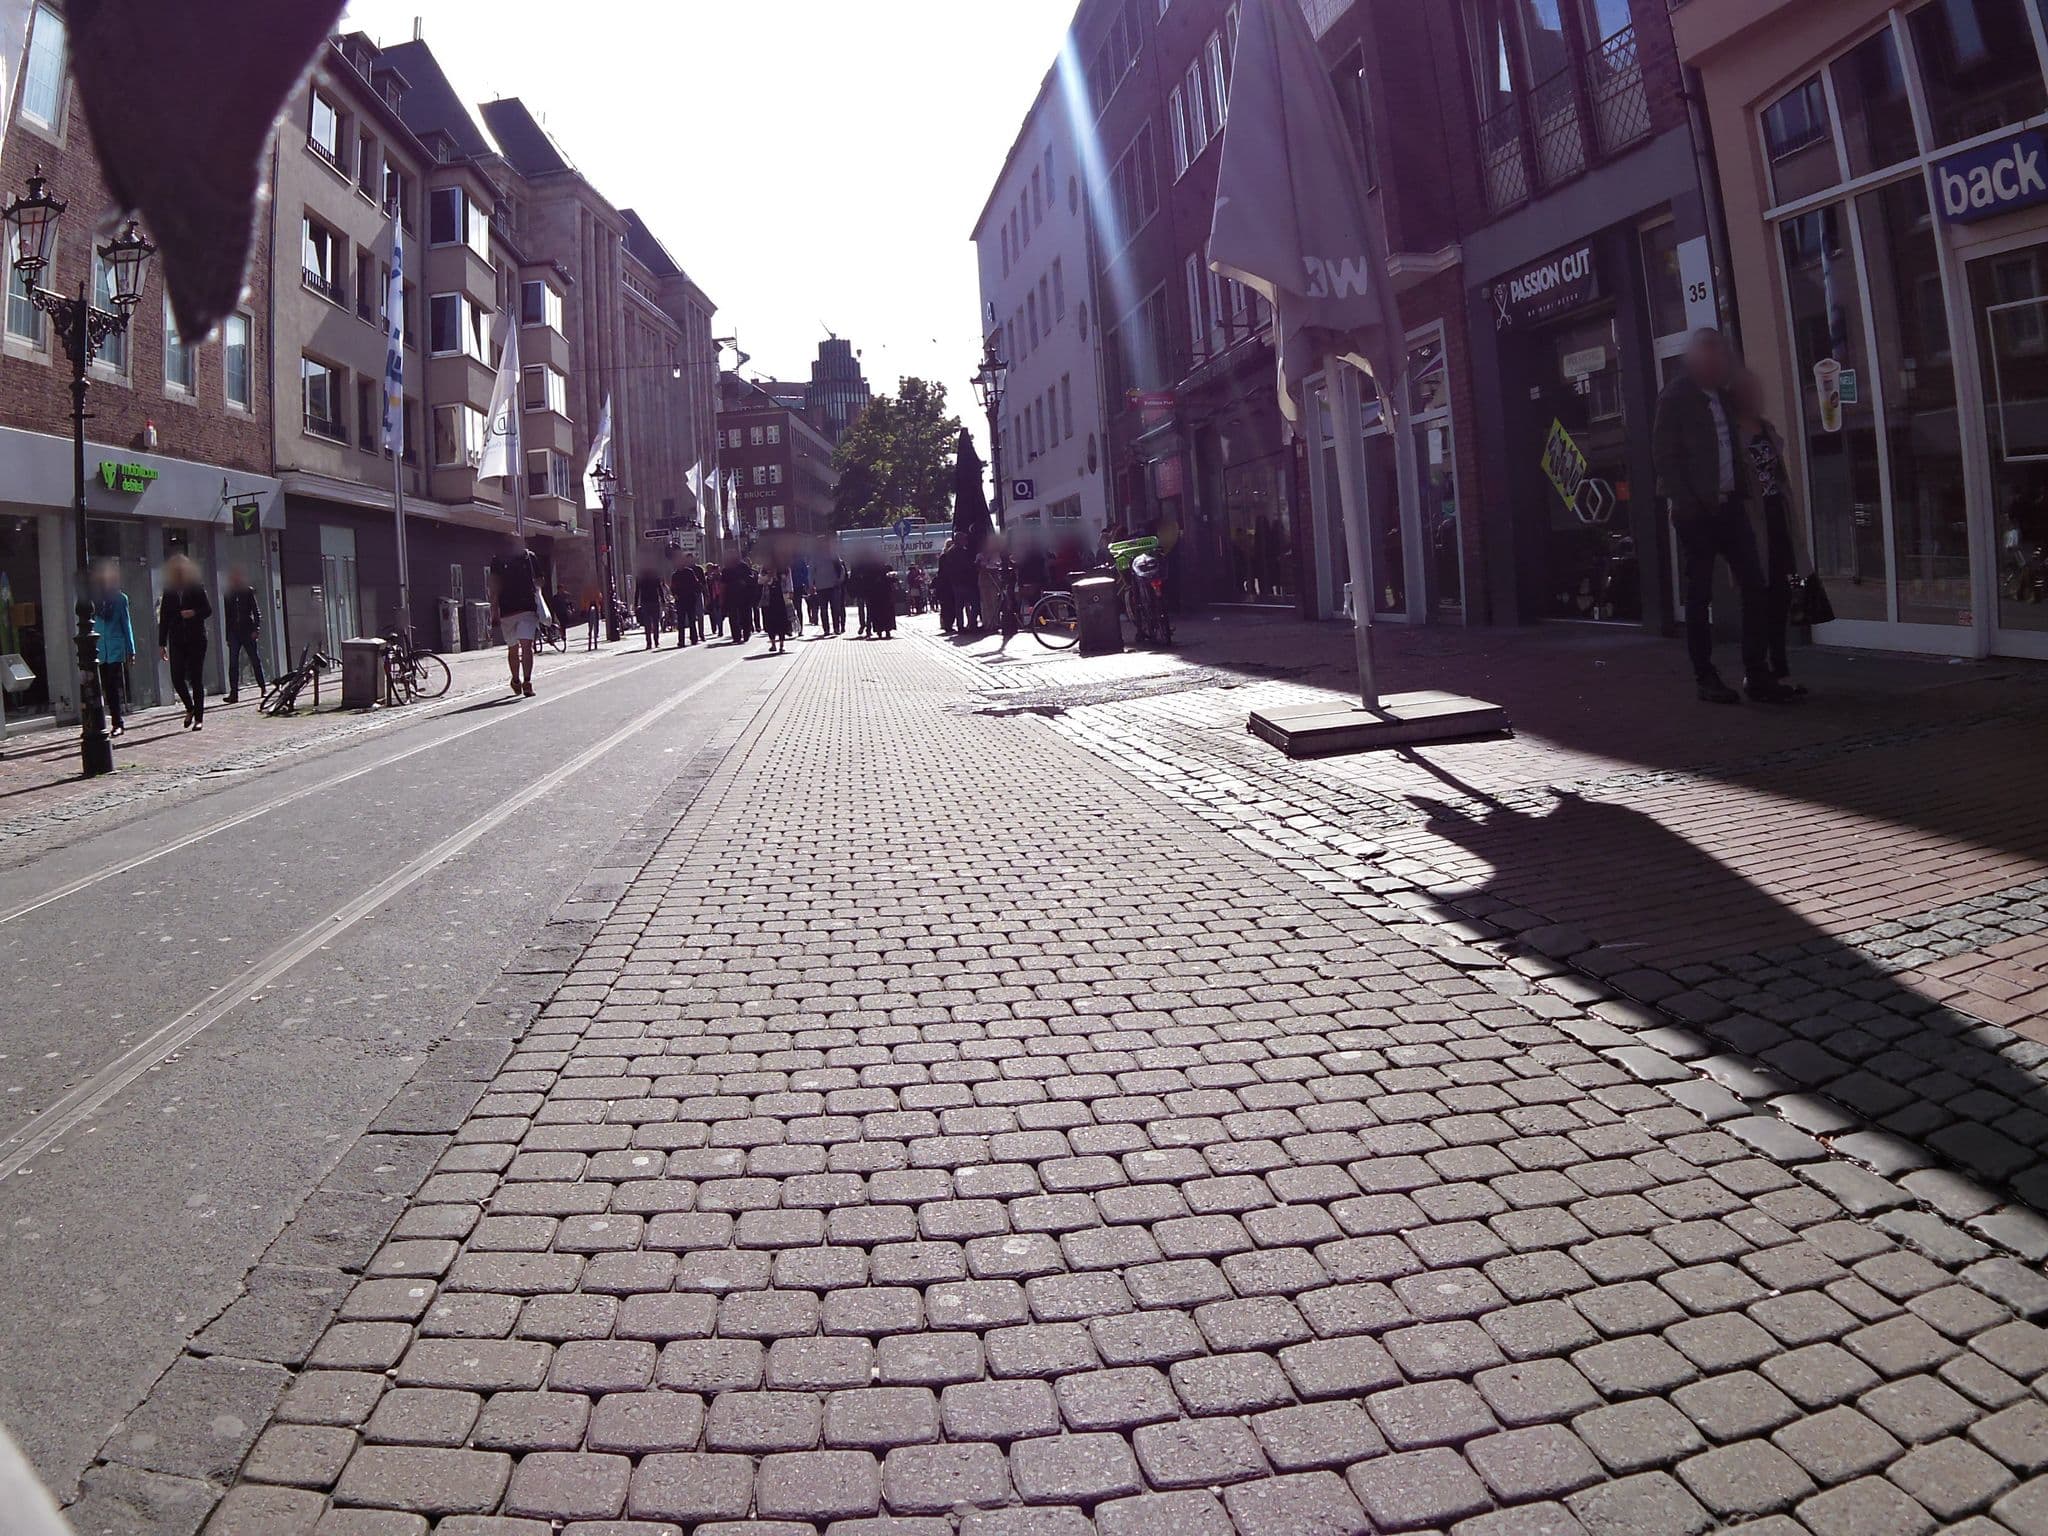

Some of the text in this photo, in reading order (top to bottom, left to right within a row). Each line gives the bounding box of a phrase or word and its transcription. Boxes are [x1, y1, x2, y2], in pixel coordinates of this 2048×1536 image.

[1939, 142, 2047, 216] back
[1510, 246, 1591, 304] PASSION CUT
[1688, 281, 1708, 304] 35
